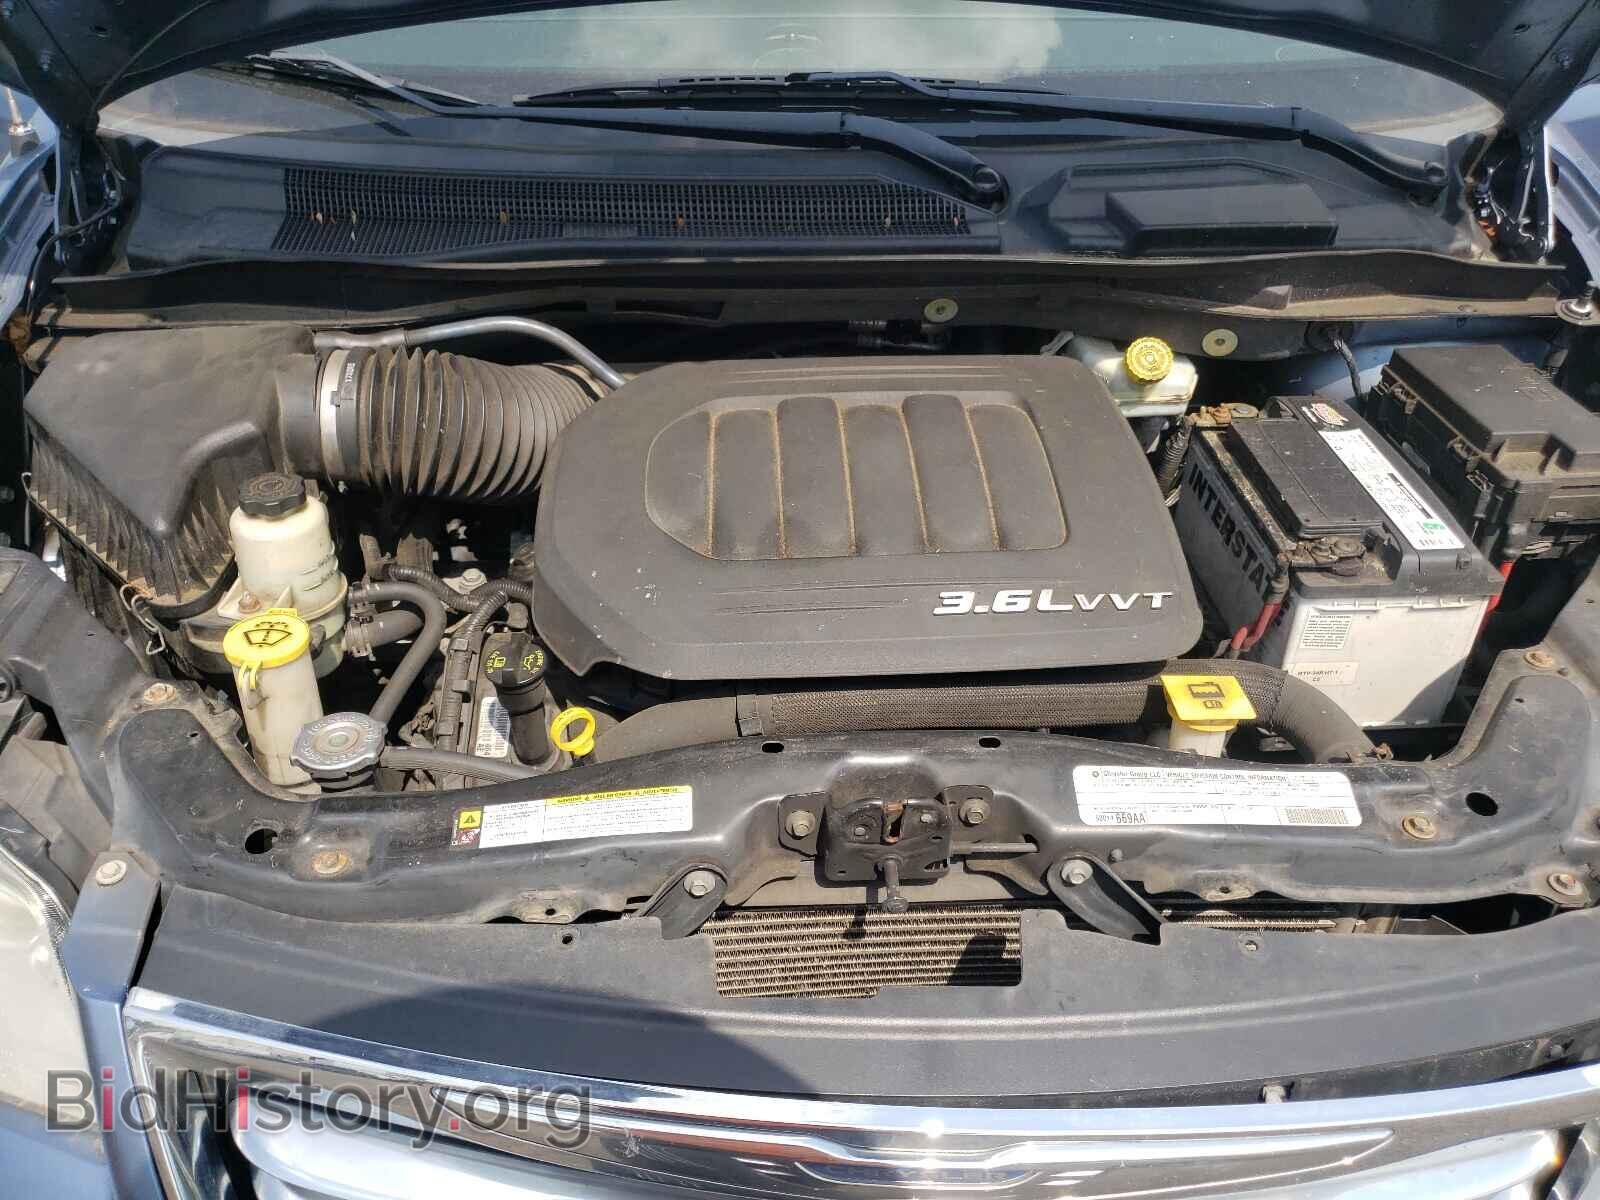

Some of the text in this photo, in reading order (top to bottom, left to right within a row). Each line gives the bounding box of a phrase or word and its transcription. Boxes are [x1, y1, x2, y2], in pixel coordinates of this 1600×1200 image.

[1188, 463, 1280, 612] INTERSTA
[933, 588, 1173, 616] 3.6L VVT
